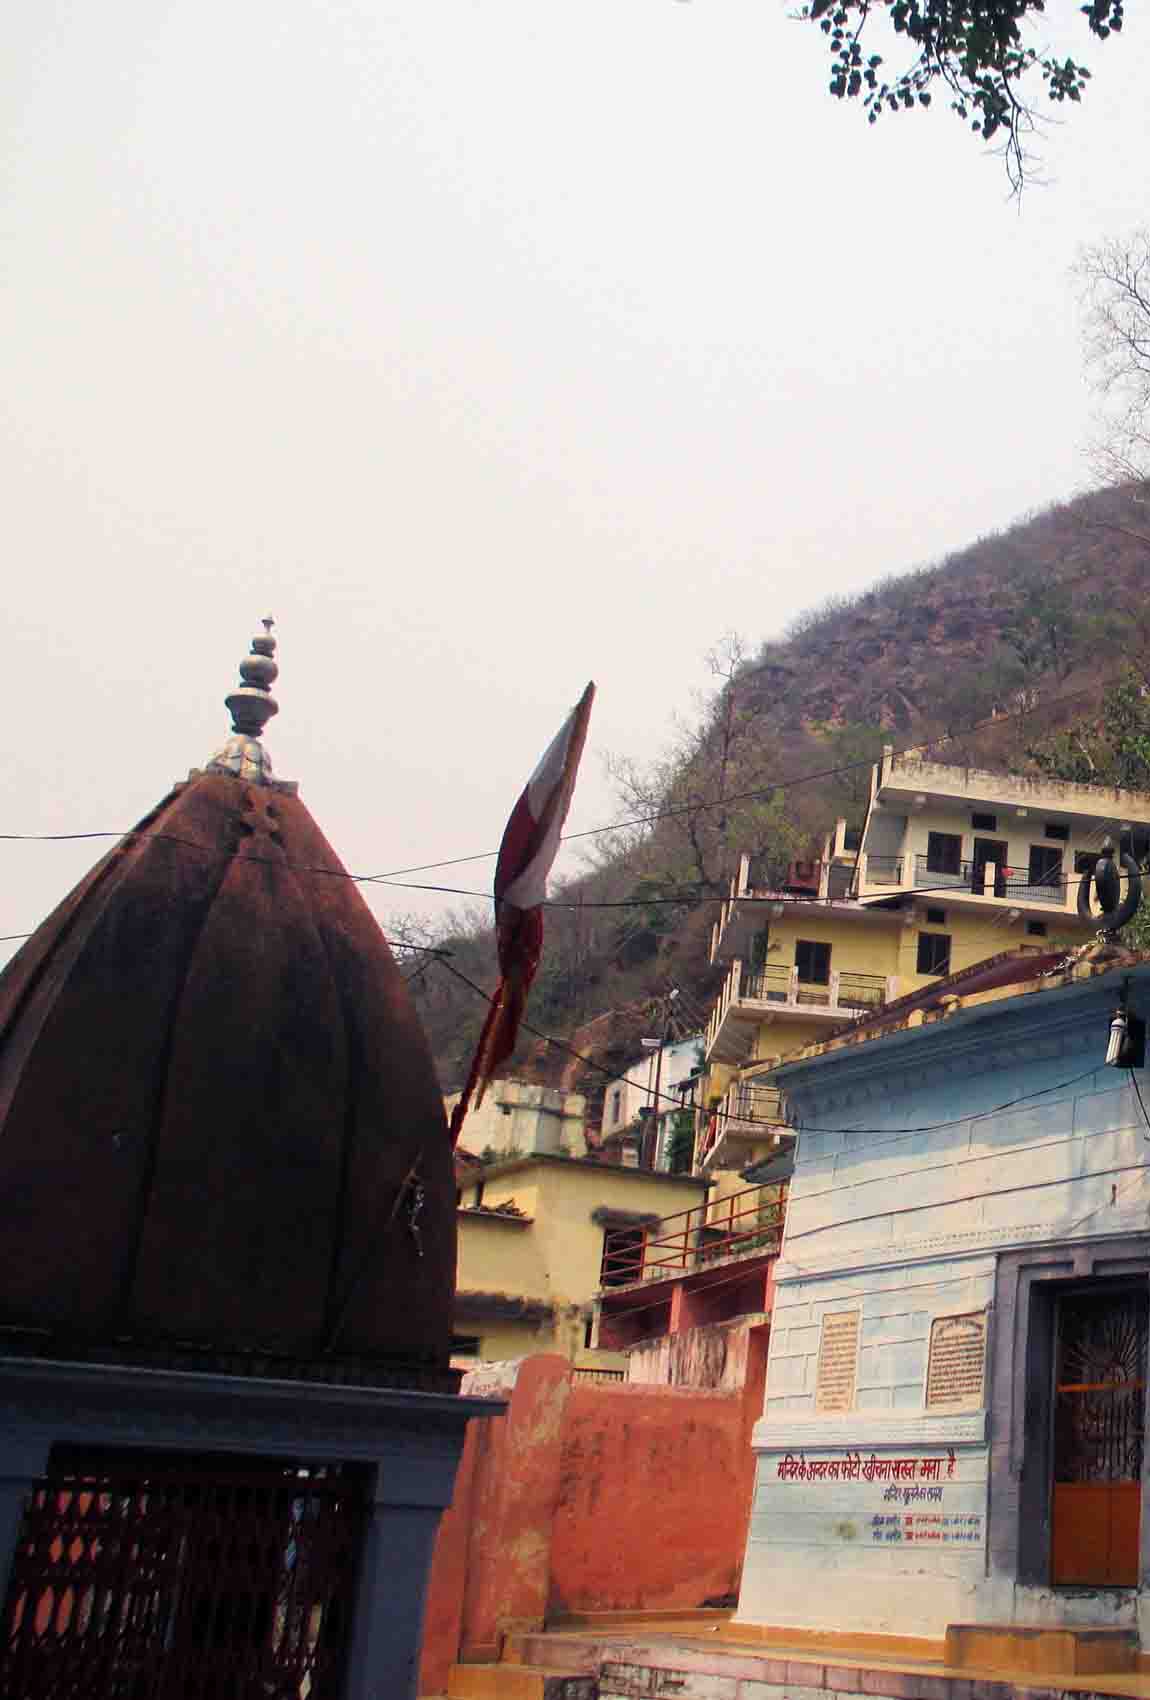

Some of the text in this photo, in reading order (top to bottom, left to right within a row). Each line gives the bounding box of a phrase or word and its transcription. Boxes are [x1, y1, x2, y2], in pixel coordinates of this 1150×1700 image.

[778, 1454, 799, 1481] मन्दिर
[841, 1452, 861, 1481] फोटो
[920, 1459, 942, 1480] मना
